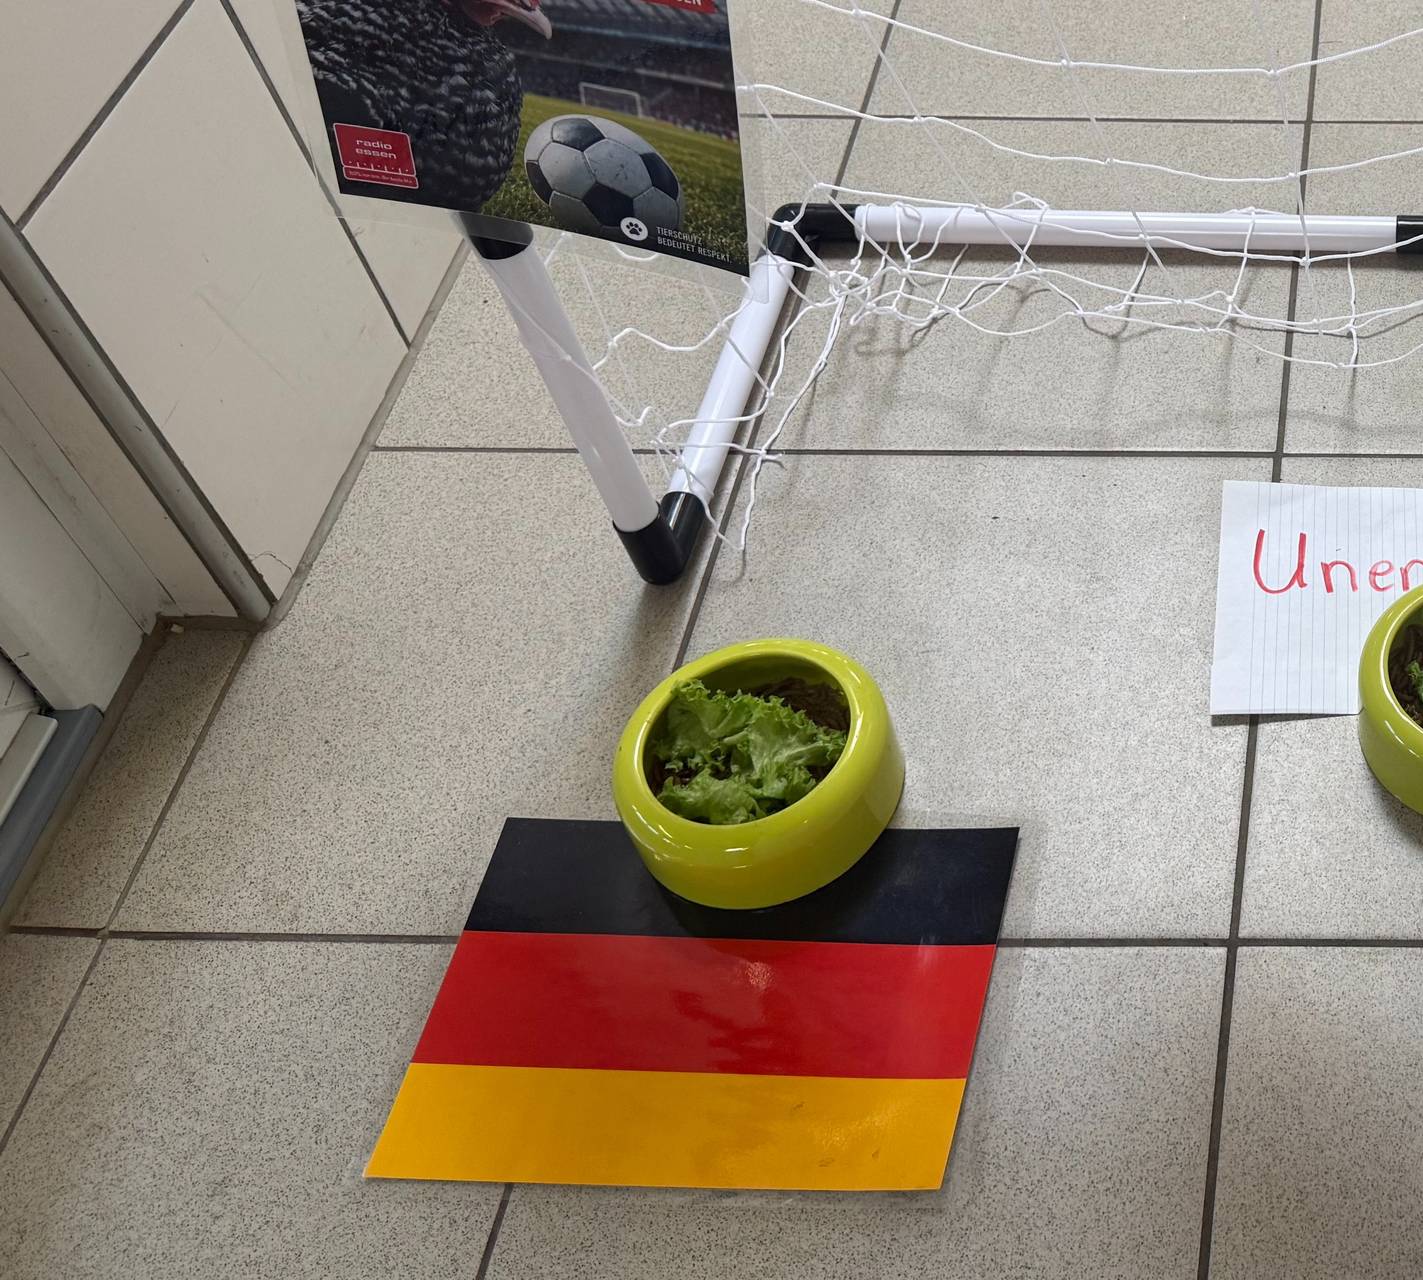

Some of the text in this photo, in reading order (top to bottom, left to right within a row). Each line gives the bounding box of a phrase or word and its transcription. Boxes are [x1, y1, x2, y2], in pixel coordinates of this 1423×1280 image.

[356, 139, 392, 150] radio
[355, 148, 397, 159] essen
[656, 226, 702, 245] TIERSCHUTZ
[657, 236, 696, 253] BEDEUTET
